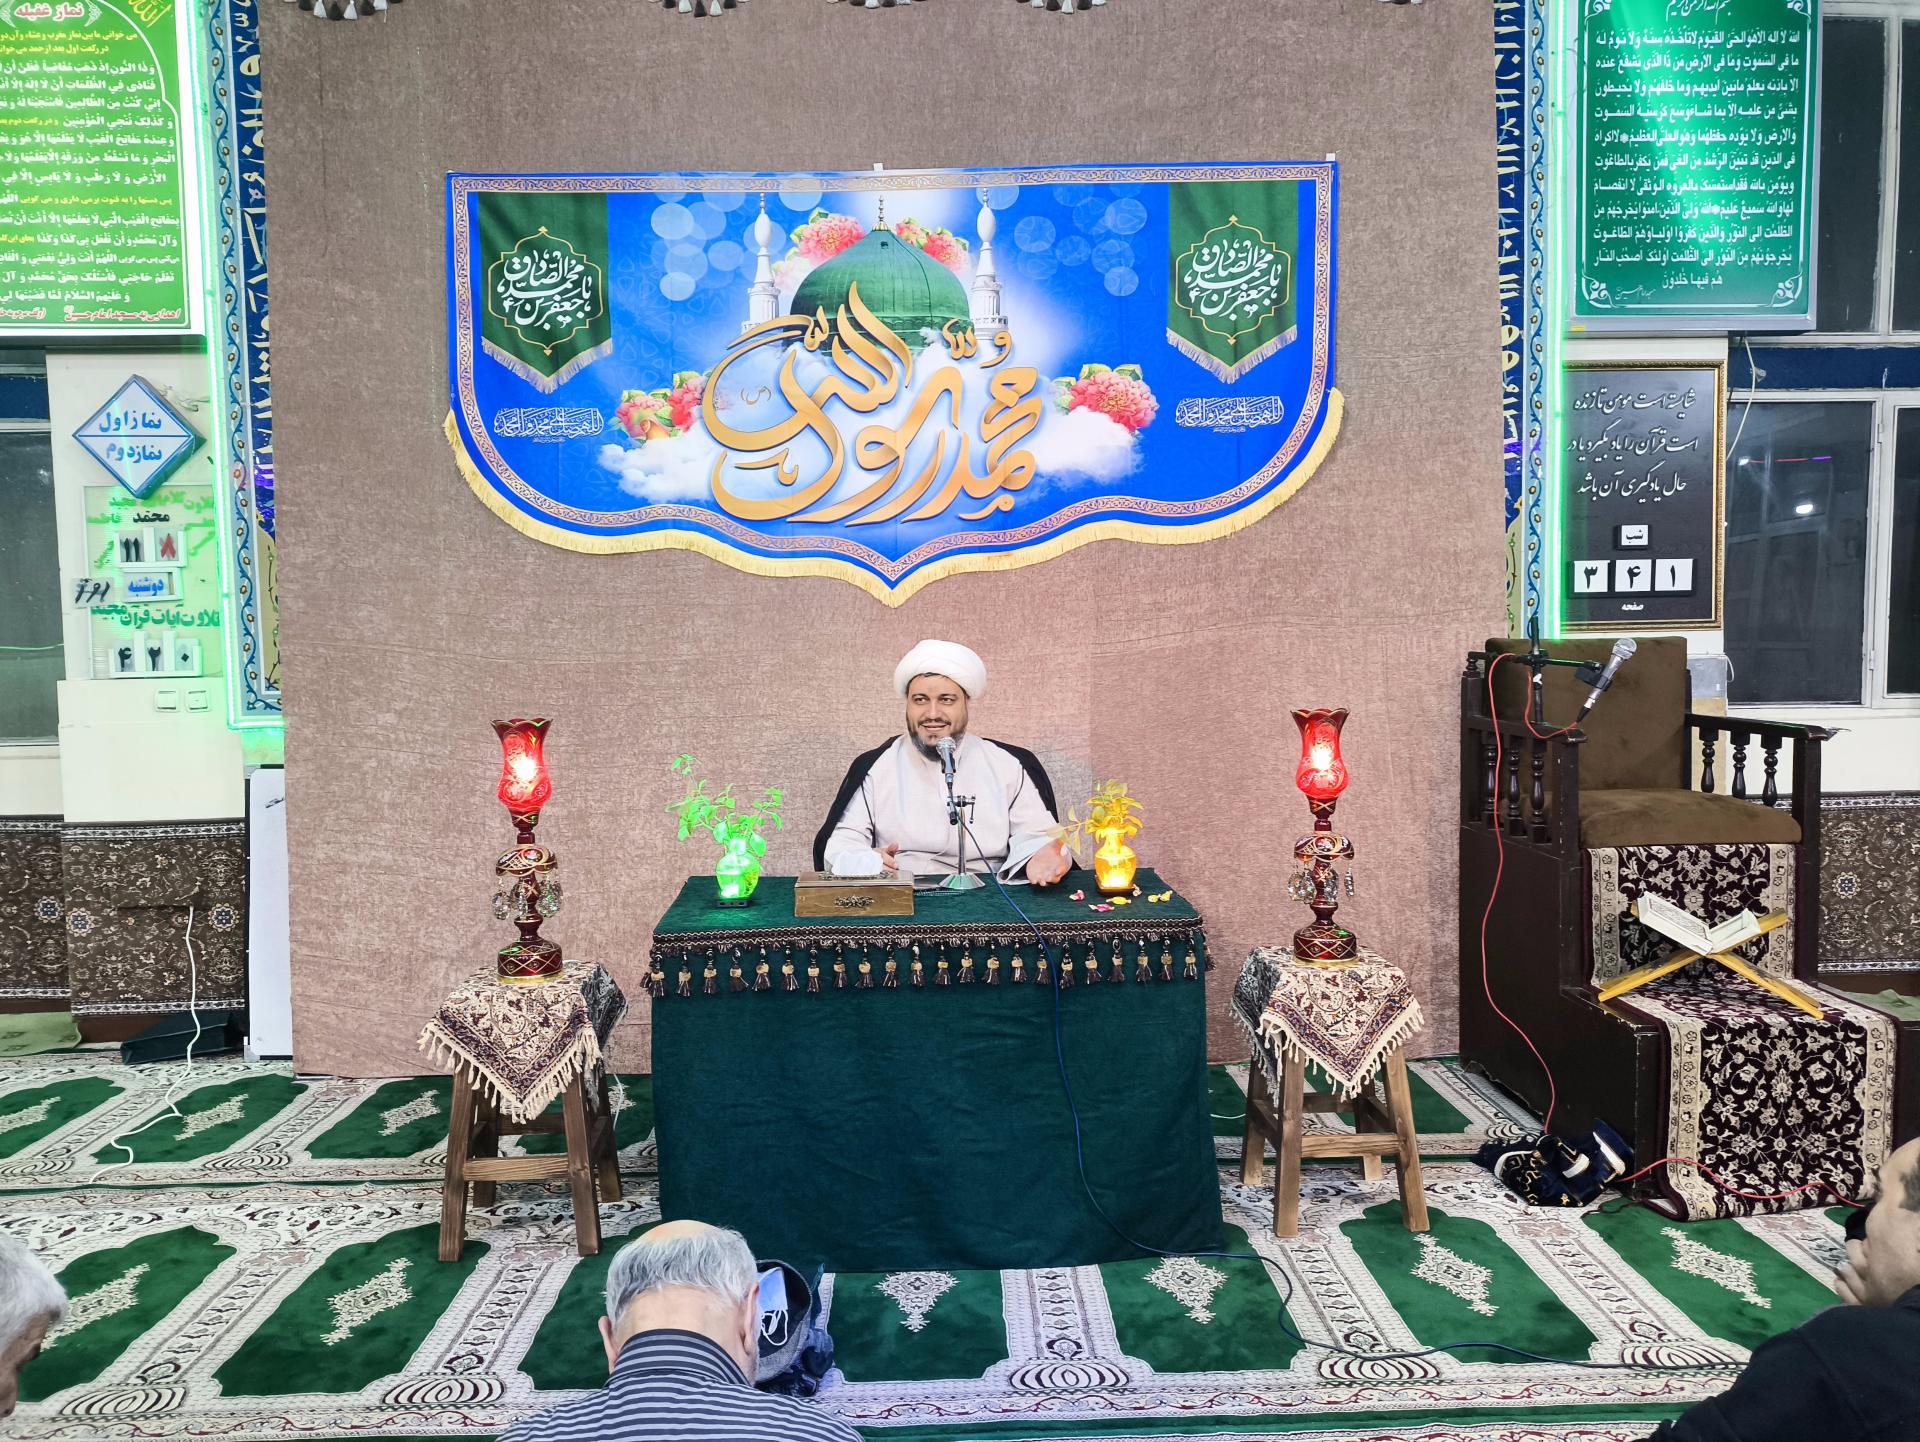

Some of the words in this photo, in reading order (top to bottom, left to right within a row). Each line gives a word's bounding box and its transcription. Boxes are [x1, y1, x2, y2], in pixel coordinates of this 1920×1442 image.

[1633, 393, 1666, 409] است
[1668, 388, 1697, 418] شایسته
[99, 411, 128, 433] اول
[130, 410, 162, 430] نماز
[902, 366, 1043, 524] محمد
[1567, 438, 1577, 451] در
[1587, 417, 1622, 461] بگیرد
[1610, 435, 1623, 461] یاد
[1635, 426, 1667, 456] قرآن
[1666, 436, 1699, 452] است
[106, 443, 135, 462] دوم
[132, 444, 162, 463] نماز
[1577, 471, 1599, 501] باشد
[1599, 469, 1625, 497] آن
[1663, 471, 1688, 496] حال
[1626, 529, 1644, 544] شب
[128, 577, 164, 597] دوشنبه
[120, 603, 150, 629] قرآن
[1620, 601, 1645, 611] صفحه
[180, 608, 220, 627] تلاوت
